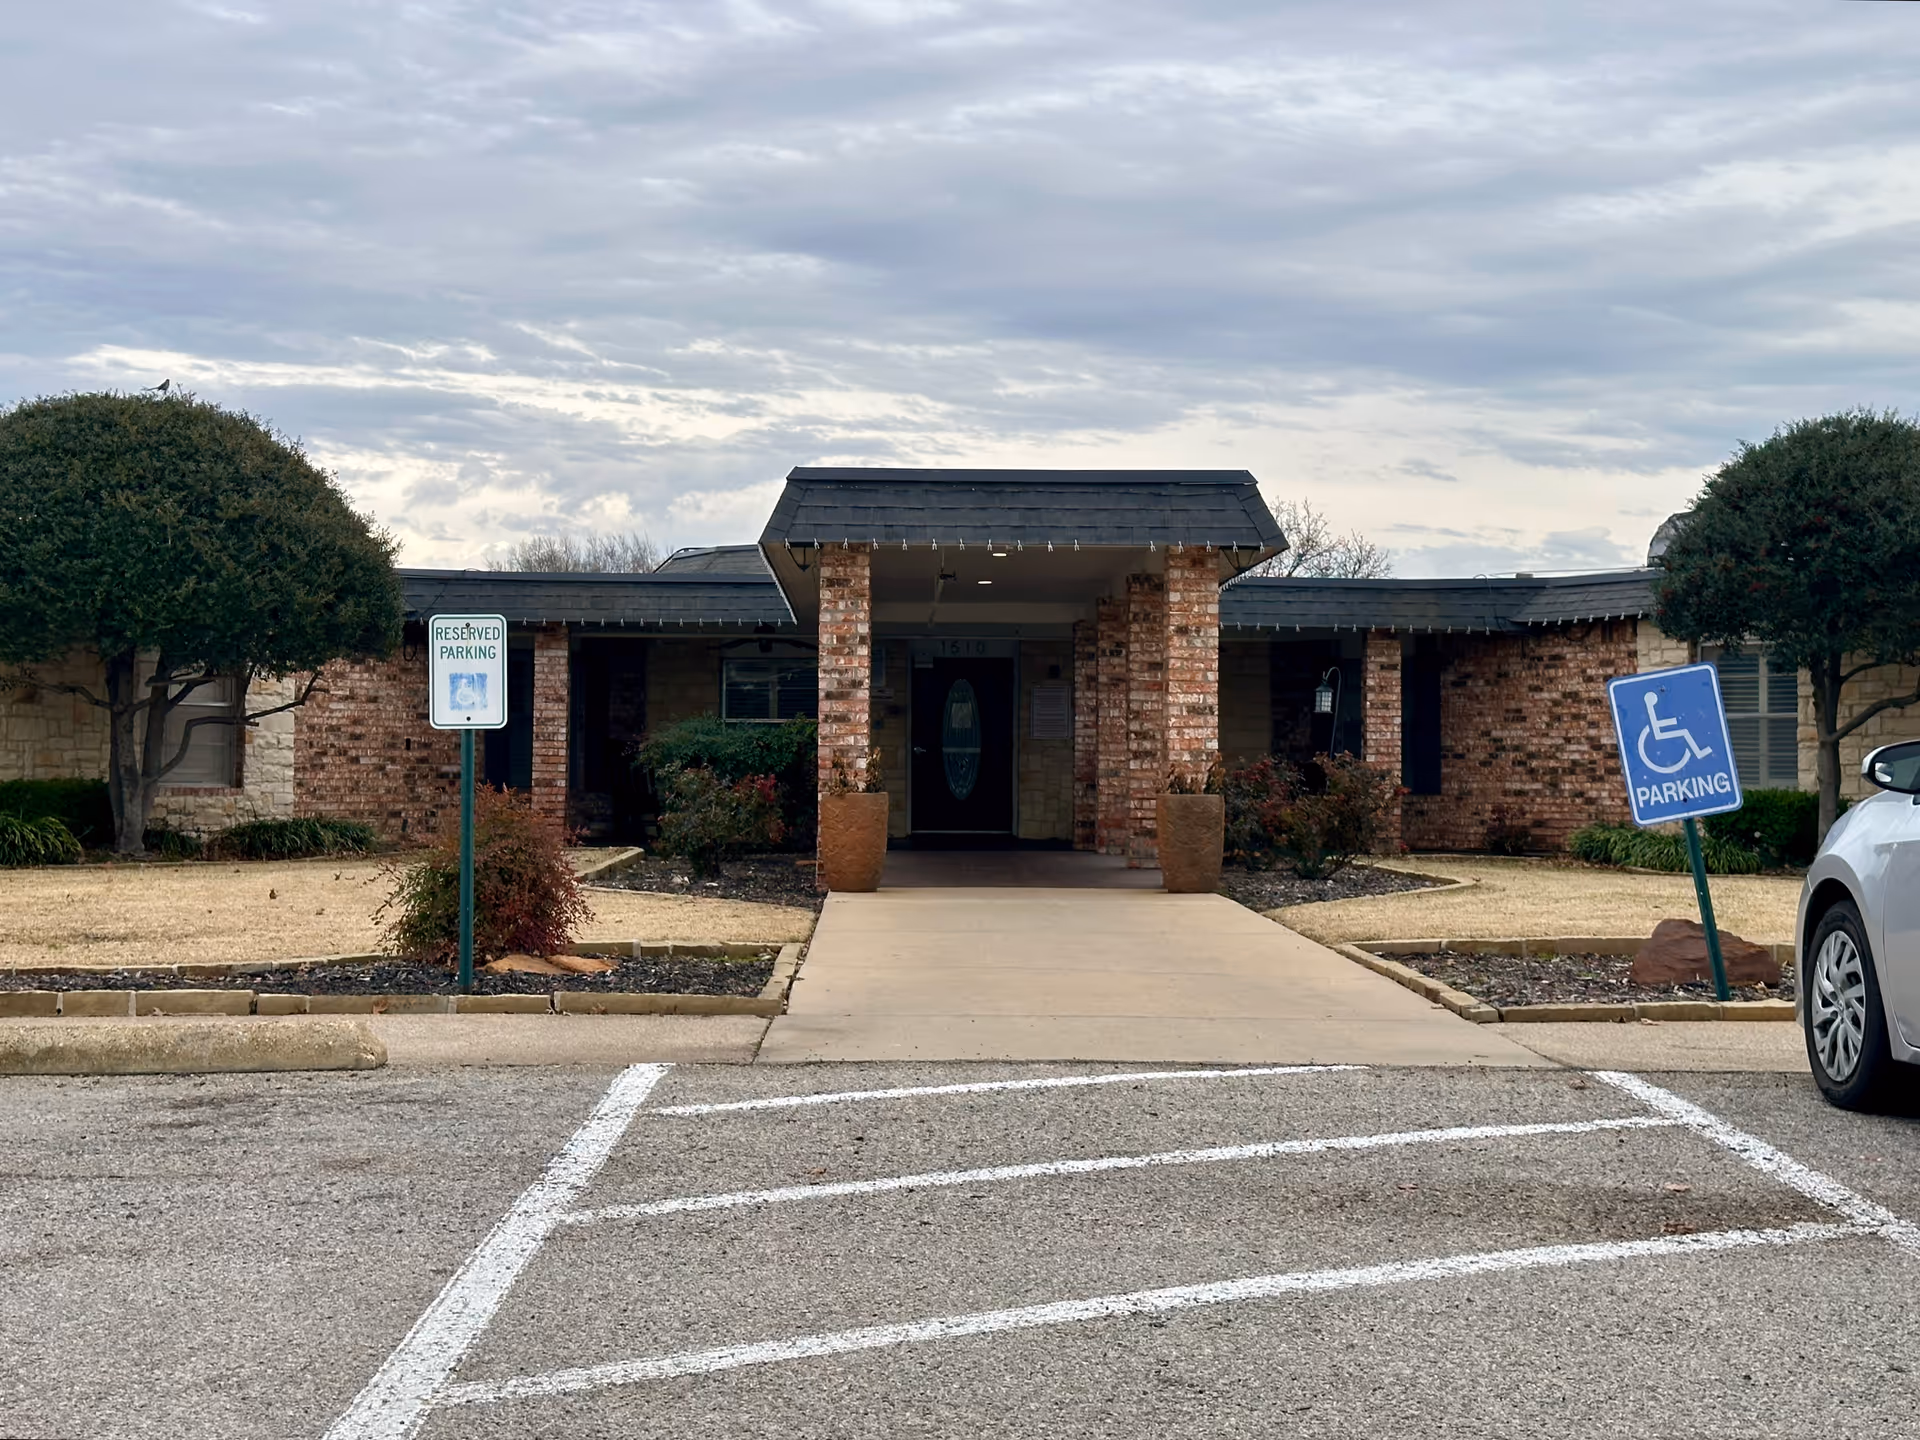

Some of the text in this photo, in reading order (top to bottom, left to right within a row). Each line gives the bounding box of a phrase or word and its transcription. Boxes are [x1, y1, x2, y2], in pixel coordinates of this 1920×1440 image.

[435, 626, 501, 641] RESERVED
[440, 645, 497, 660] PARKING
[1636, 772, 1732, 808] PARKING
